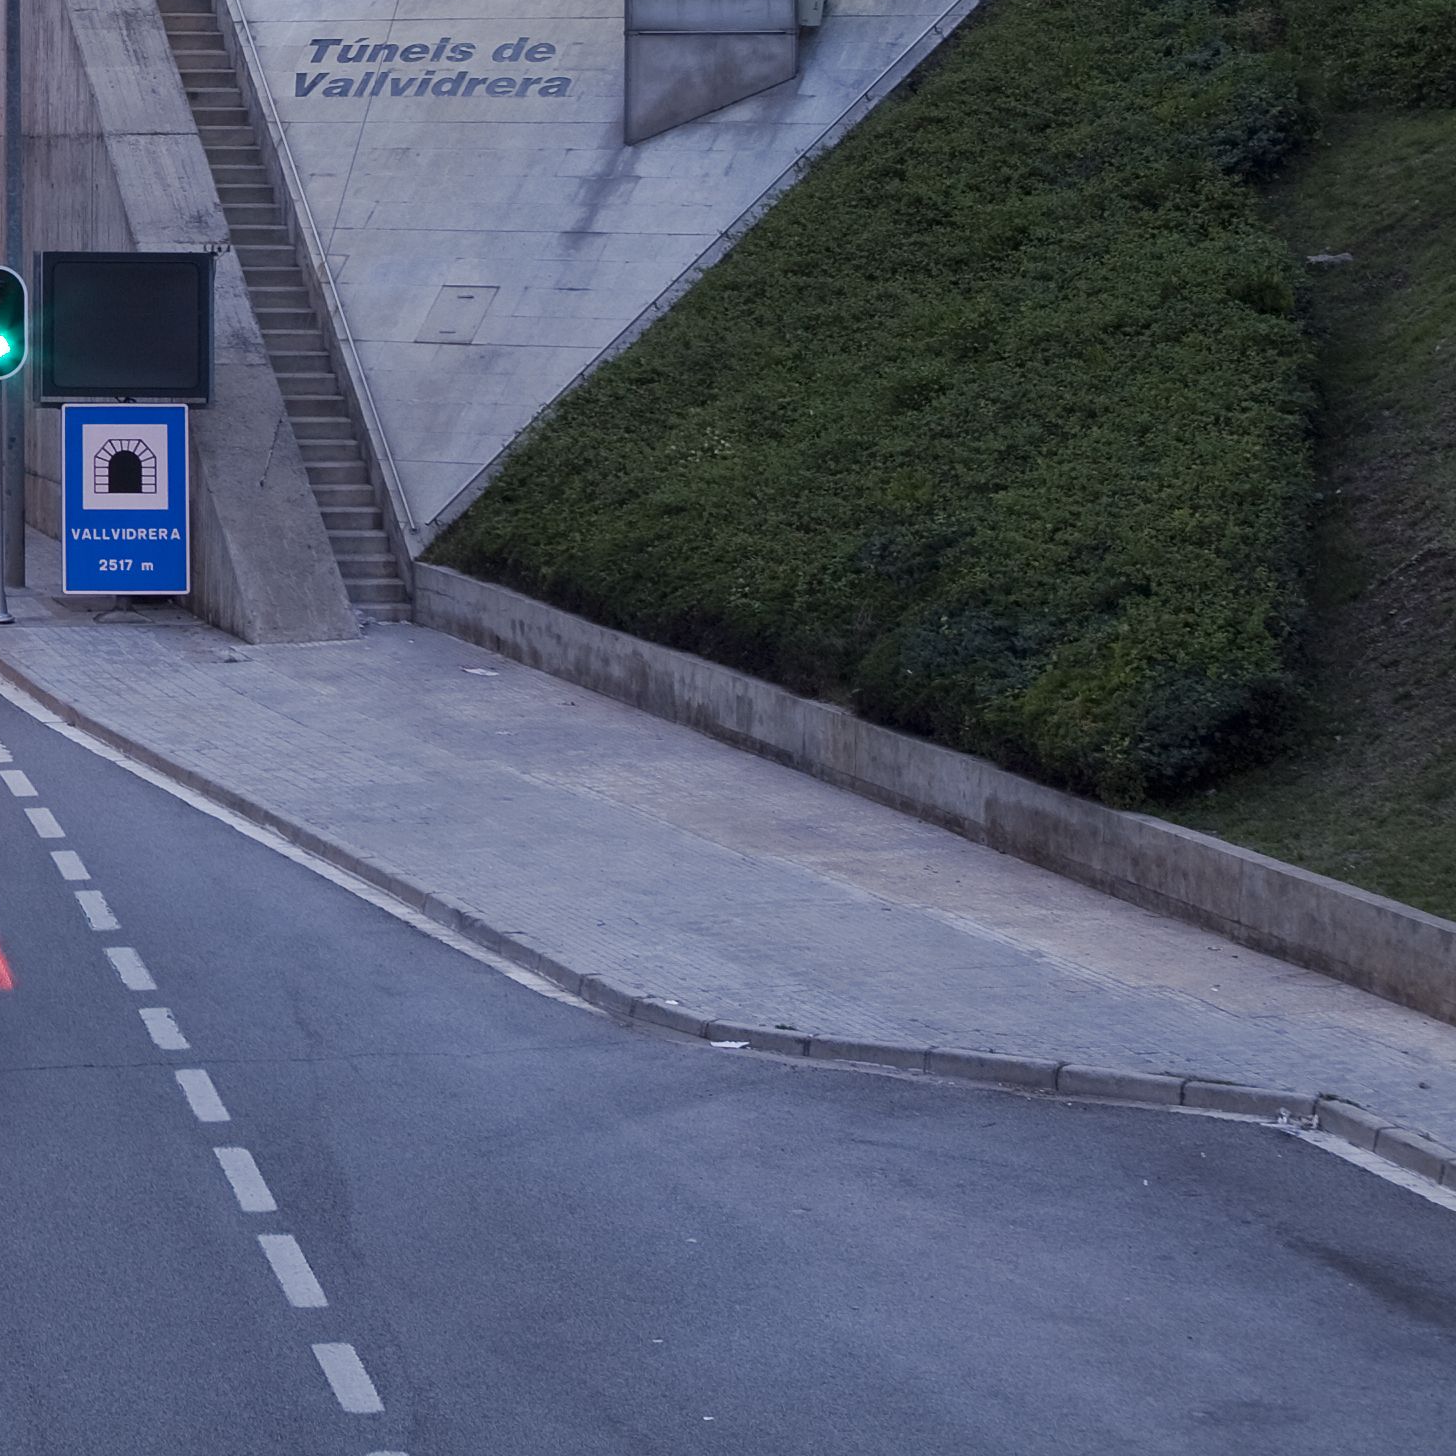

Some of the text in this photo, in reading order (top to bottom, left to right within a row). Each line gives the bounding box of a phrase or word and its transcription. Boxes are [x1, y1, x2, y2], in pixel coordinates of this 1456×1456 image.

[309, 37, 556, 64] Túnels de
[294, 70, 573, 98] Vallvidrera
[71, 528, 181, 540] VALLVIDRERA
[98, 559, 154, 571] 2517 m
